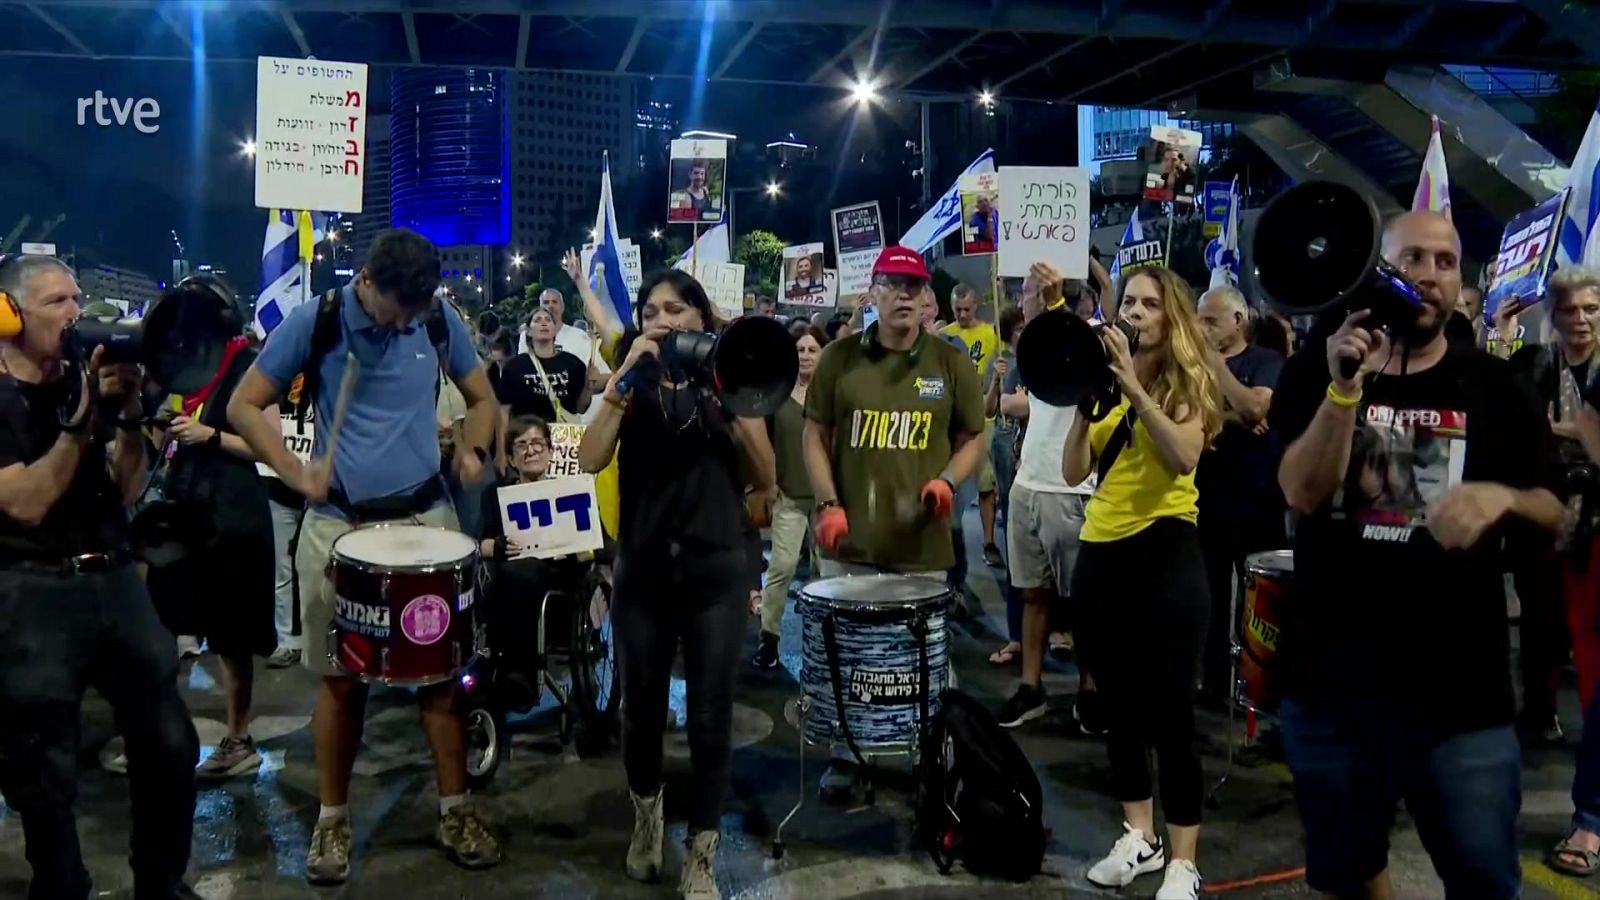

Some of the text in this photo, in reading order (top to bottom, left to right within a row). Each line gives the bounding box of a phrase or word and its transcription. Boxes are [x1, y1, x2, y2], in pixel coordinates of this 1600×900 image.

[273, 60, 353, 80] החטופים על
[1020, 203, 1077, 220] הנחיתי
[548, 459, 580, 475] THE
[884, 685, 912, 697] קידוש
